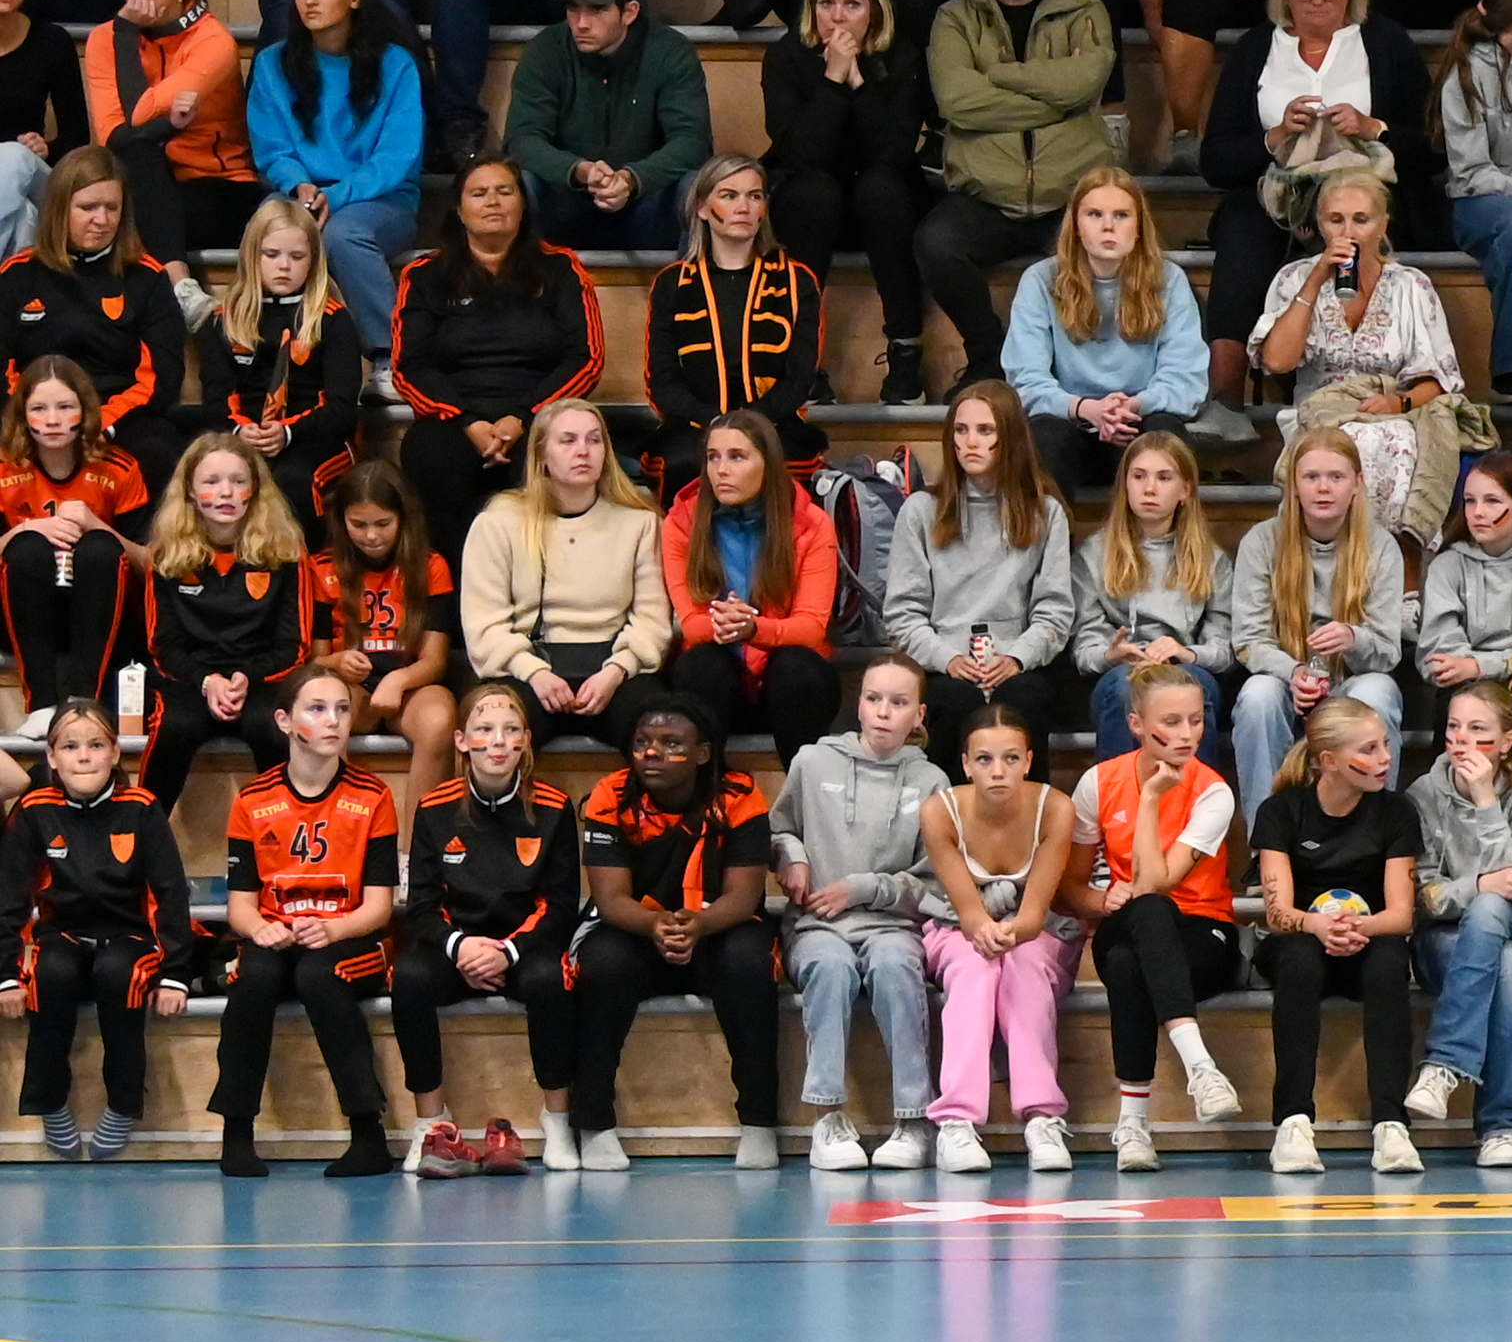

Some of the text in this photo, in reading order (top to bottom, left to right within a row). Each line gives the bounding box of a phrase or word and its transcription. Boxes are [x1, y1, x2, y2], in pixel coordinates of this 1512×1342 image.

[0, 471, 117, 491] EXTRA EXTRA
[252, 799, 371, 820] EXTRA EXTRA
[291, 820, 329, 865] 45
[282, 899, 339, 915] BOLIG
